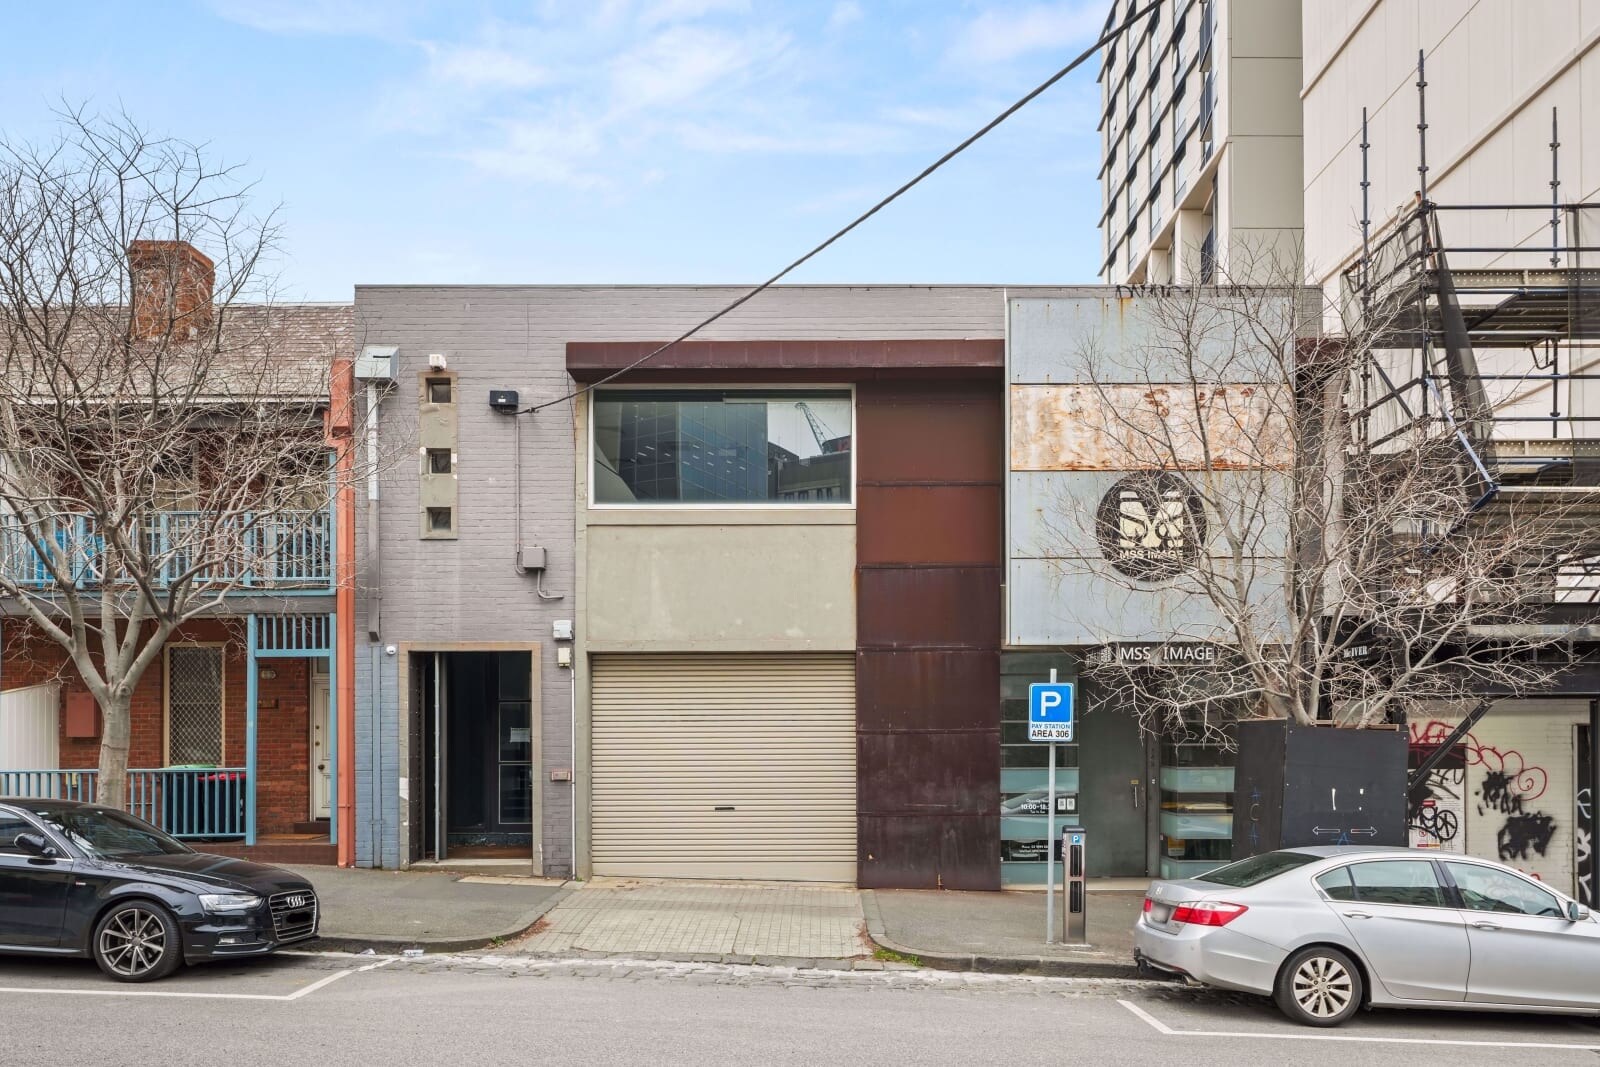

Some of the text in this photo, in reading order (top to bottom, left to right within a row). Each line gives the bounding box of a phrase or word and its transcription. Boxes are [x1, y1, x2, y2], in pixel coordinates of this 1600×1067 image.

[1120, 550, 1144, 559] MSS
[1121, 646, 1213, 660] MSS IMAGE
[1040, 691, 1062, 717] P
[1032, 729, 1070, 738] AREA 306
[1073, 835, 1079, 843] P
